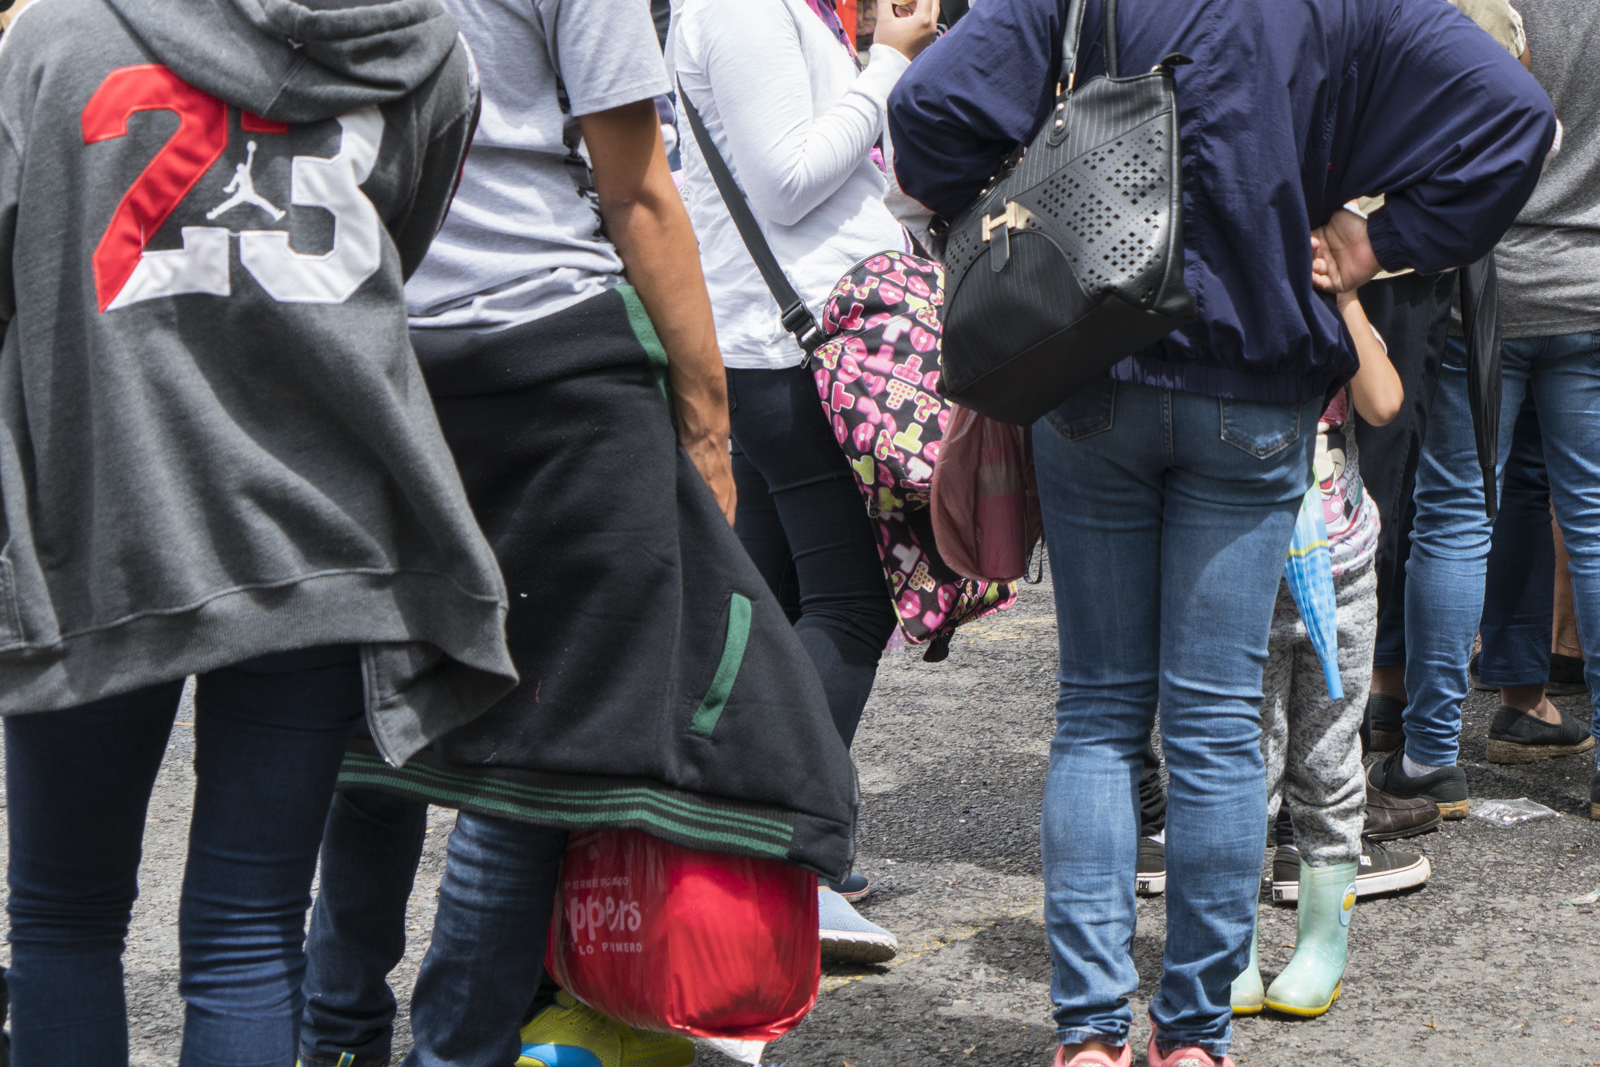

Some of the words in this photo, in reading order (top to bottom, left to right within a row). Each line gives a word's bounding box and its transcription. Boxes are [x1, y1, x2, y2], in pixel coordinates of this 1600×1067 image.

[81, 63, 386, 314] 23
[565, 895, 642, 943] ppers
[578, 944, 595, 955] LO
